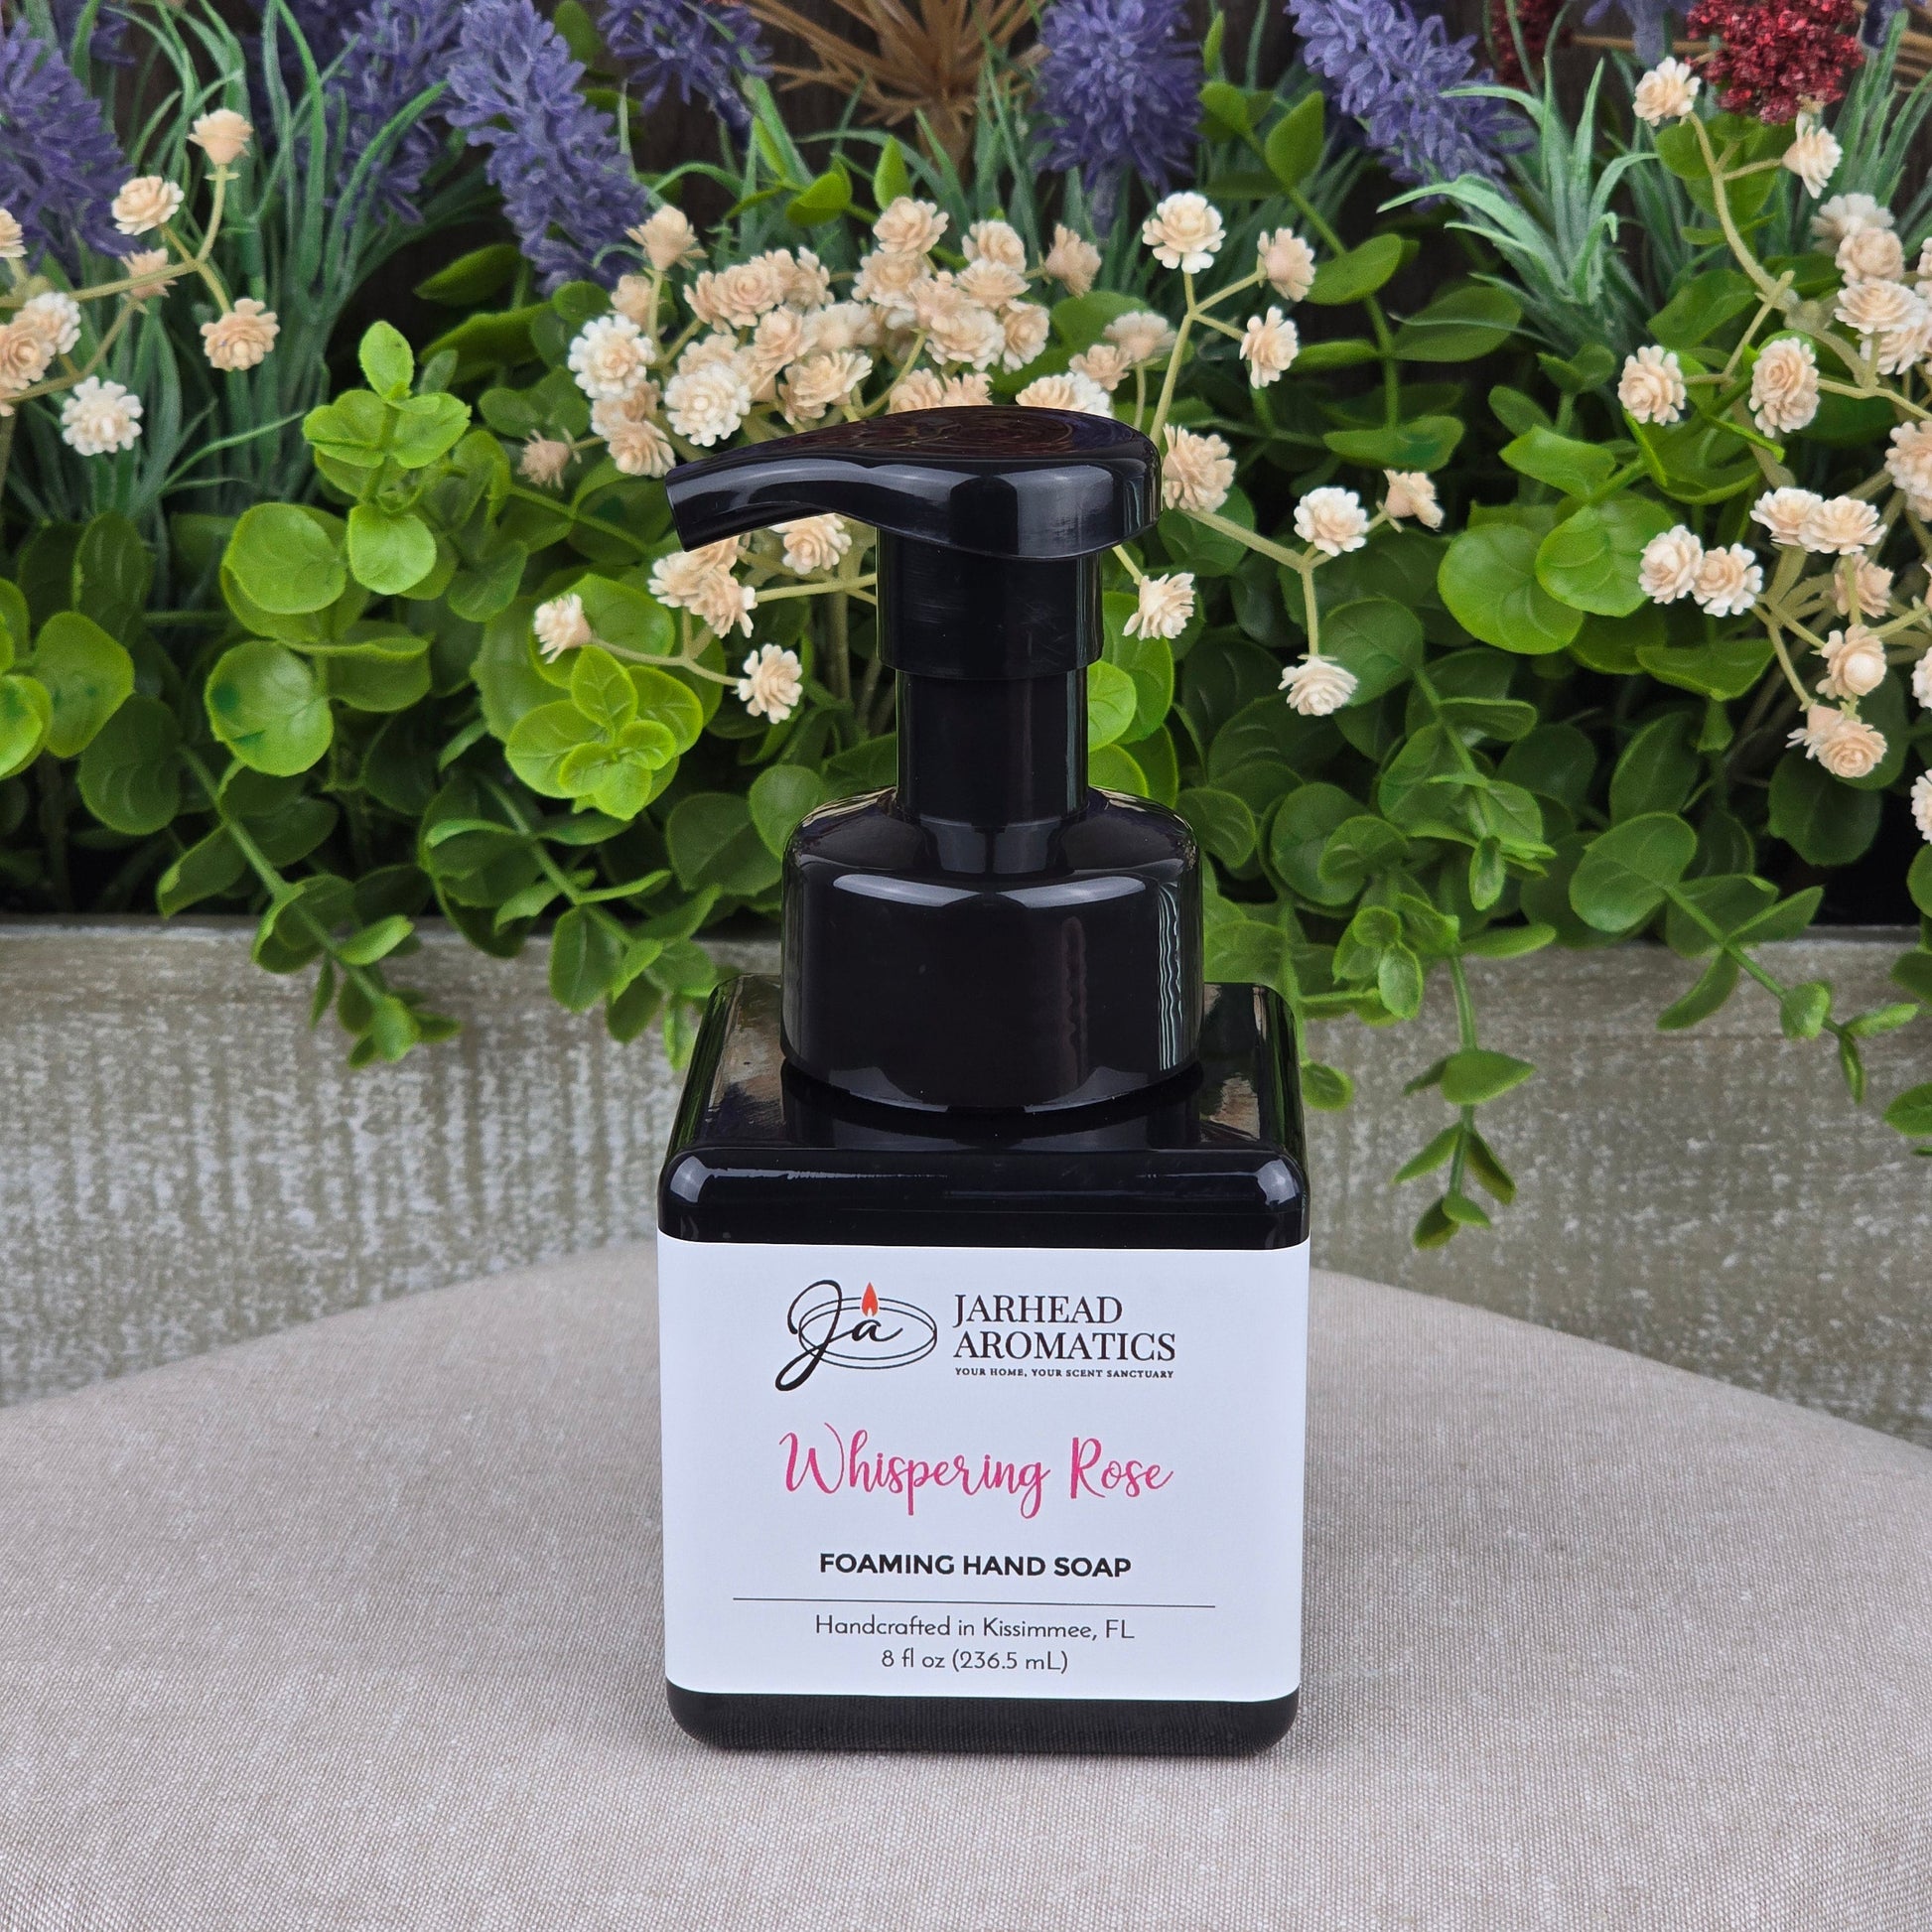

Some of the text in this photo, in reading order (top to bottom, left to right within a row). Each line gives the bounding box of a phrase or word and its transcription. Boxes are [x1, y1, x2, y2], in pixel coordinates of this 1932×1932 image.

[952, 1294, 1123, 1328] JARHEAD
[952, 1330, 1175, 1362] AROMATICS
[954, 1367, 1174, 1379] YOUR HOME, YOUR SCENT SANCTUARY
[778, 1422, 1174, 1520] Whispering Rose
[819, 1553, 1132, 1579] FOAMING HAND SOAP
[815, 1613, 1136, 1642] Handcrafted in Kissimmee, FL
[881, 1647, 1068, 1675] 8 fl oz (236.5 mL)
